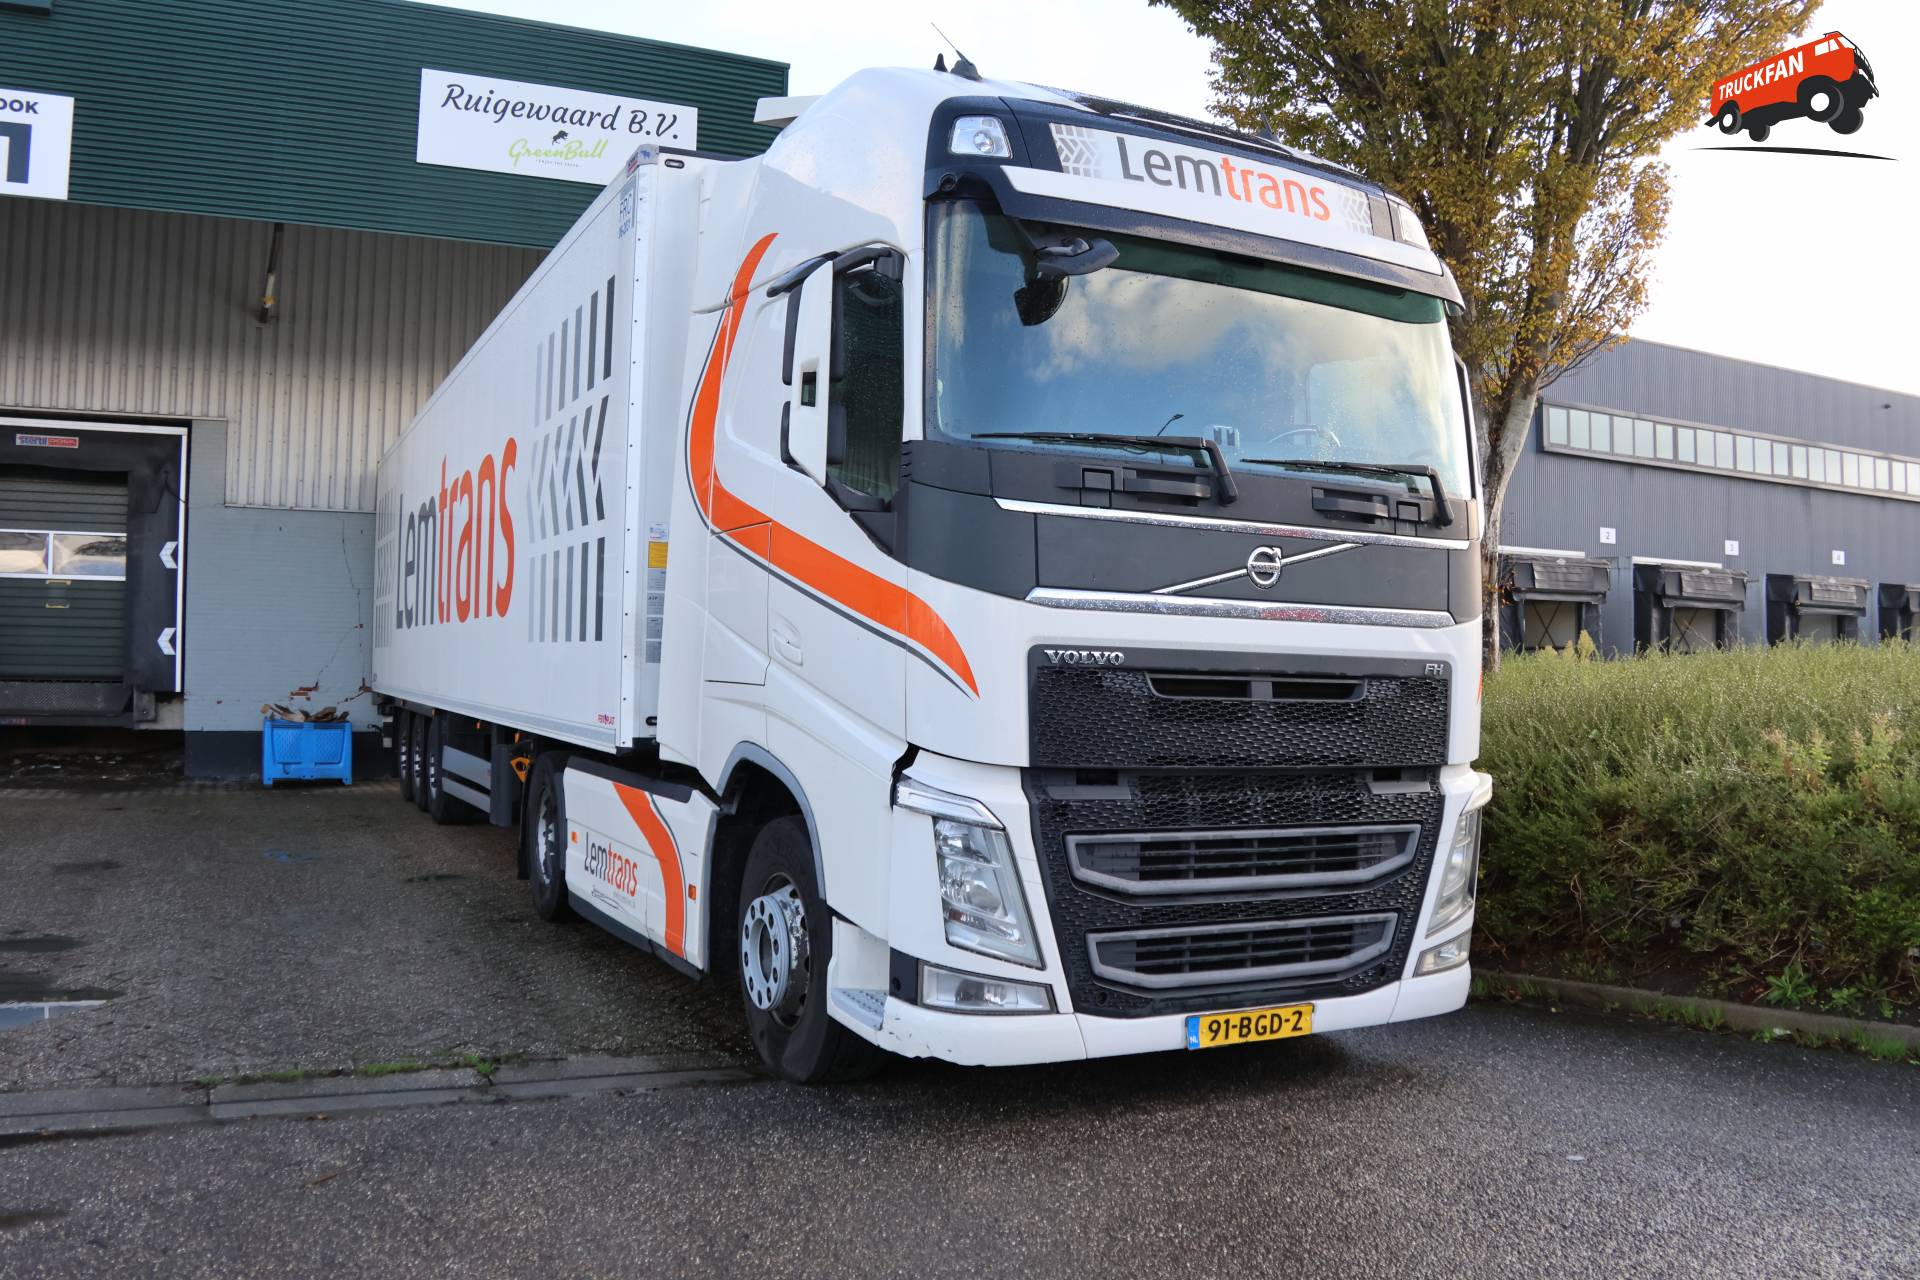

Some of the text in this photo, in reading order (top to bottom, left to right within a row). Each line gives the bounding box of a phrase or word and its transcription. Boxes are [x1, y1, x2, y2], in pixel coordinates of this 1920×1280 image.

[441, 83, 679, 140] Ruigewaard B.V.
[508, 138, 609, 168] GreenBull
[1116, 136, 1331, 222] Lemtrans
[396, 436, 518, 630] Lemtrans
[1043, 649, 1125, 666] VOLVO
[1424, 663, 1444, 675] FH
[584, 831, 638, 897] Lemtrans
[1208, 1010, 1303, 1041] 91-BGD-2
